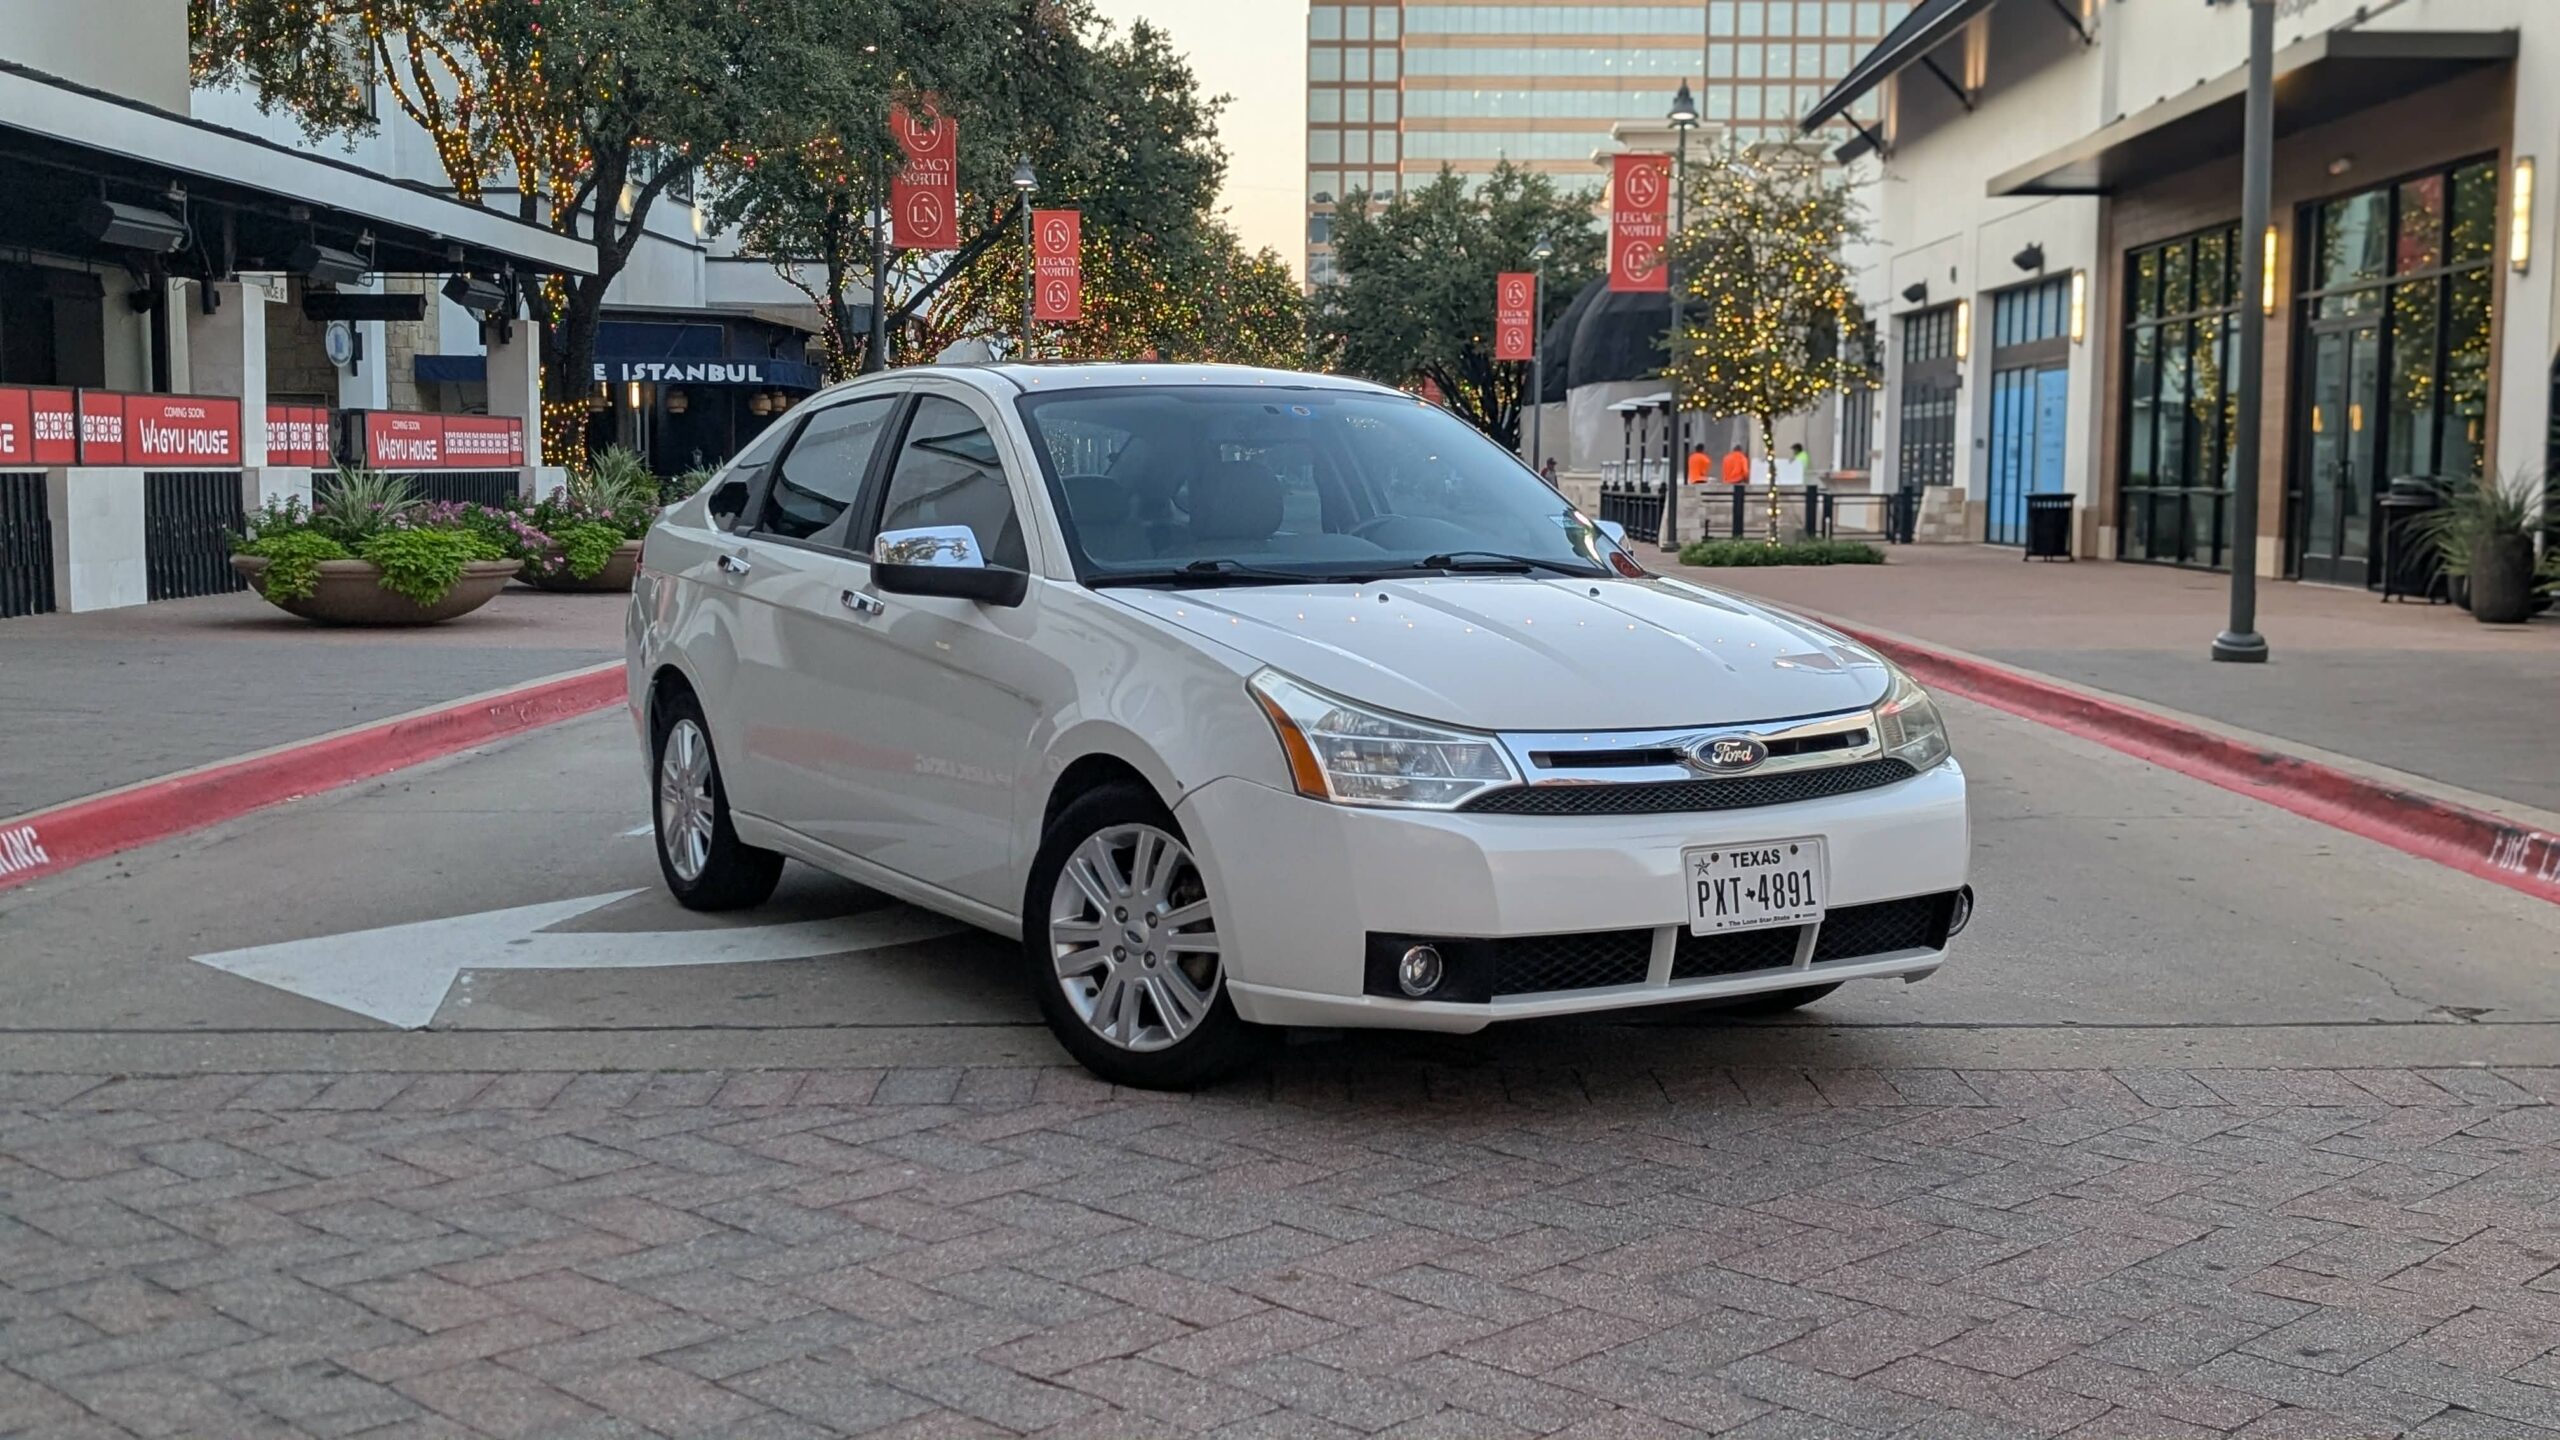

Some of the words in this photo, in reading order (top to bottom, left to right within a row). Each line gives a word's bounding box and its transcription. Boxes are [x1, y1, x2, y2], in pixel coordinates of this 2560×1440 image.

[904, 158, 952, 171] GACY
[1631, 178, 1654, 194] LN
[913, 206, 937, 222] LN
[1616, 212, 1661, 223] LEGAC
[1048, 230, 1066, 242] LN
[1619, 225, 1661, 236] NORTH
[1037, 257, 1077, 266] LEGACY
[1041, 267, 1074, 277] NORTH
[1049, 290, 1067, 302] LN
[1508, 288, 1523, 299] LN
[1499, 309, 1529, 317] LEGACY
[621, 363, 764, 382] ISTANBUL
[164, 406, 188, 418] COMING
[140, 418, 185, 453] WAGYU
[188, 430, 229, 454] HOUSE
[376, 431, 407, 460] WAGYU
[409, 439, 438, 460] HOUSE
[1712, 741, 1753, 763] Ford
[1730, 849, 1781, 869] TEXAS
[1697, 877, 1741, 918] PXT
[1758, 869, 1816, 910] 4891
